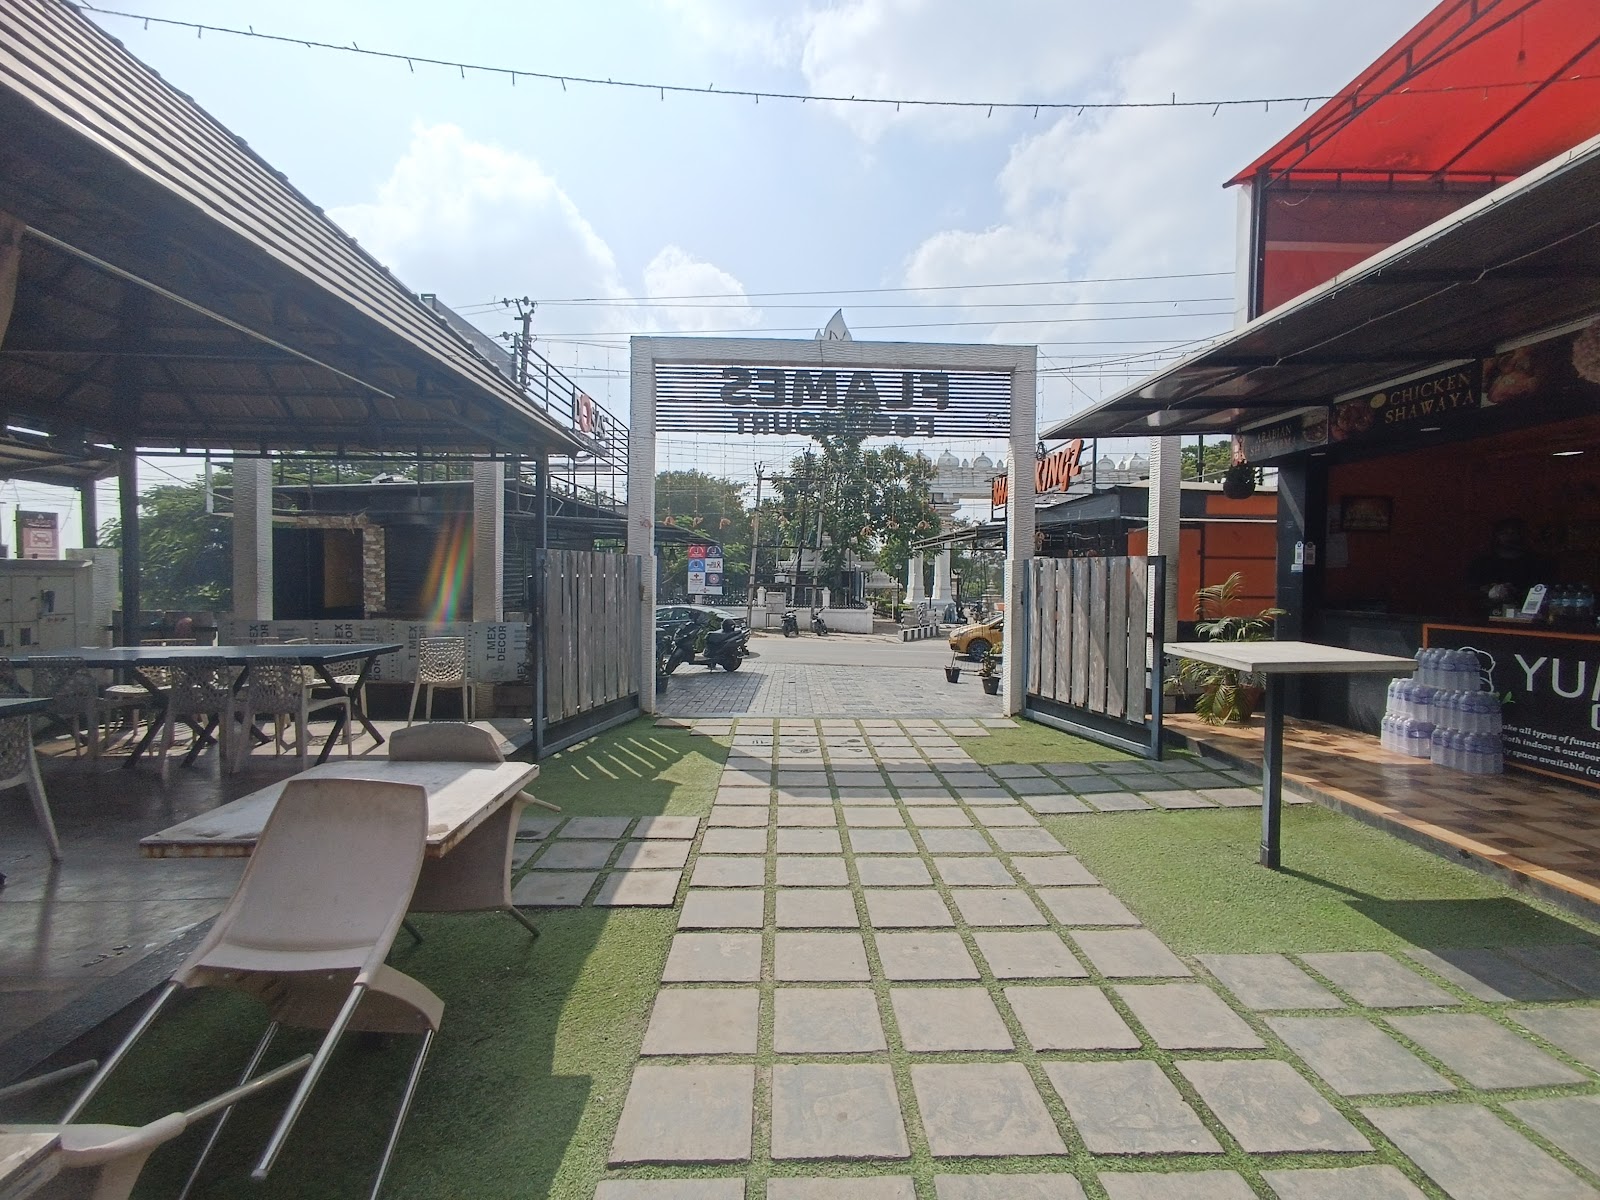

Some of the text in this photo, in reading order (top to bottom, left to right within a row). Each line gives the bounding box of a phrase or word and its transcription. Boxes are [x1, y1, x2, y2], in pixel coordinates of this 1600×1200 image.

[1390, 371, 1471, 405] CHICKEN
[1385, 390, 1474, 424] SHAWAYA
[497, 625, 506, 662] DECOR
[1514, 654, 1600, 702] YU
[1518, 727, 1532, 735] all
[1532, 729, 1557, 741] types
[1558, 735, 1570, 744] of
[1522, 739, 1554, 752] indoor
[1562, 749, 1600, 763] outdoor
[1511, 750, 1538, 761] space
[1538, 756, 1585, 772] available
